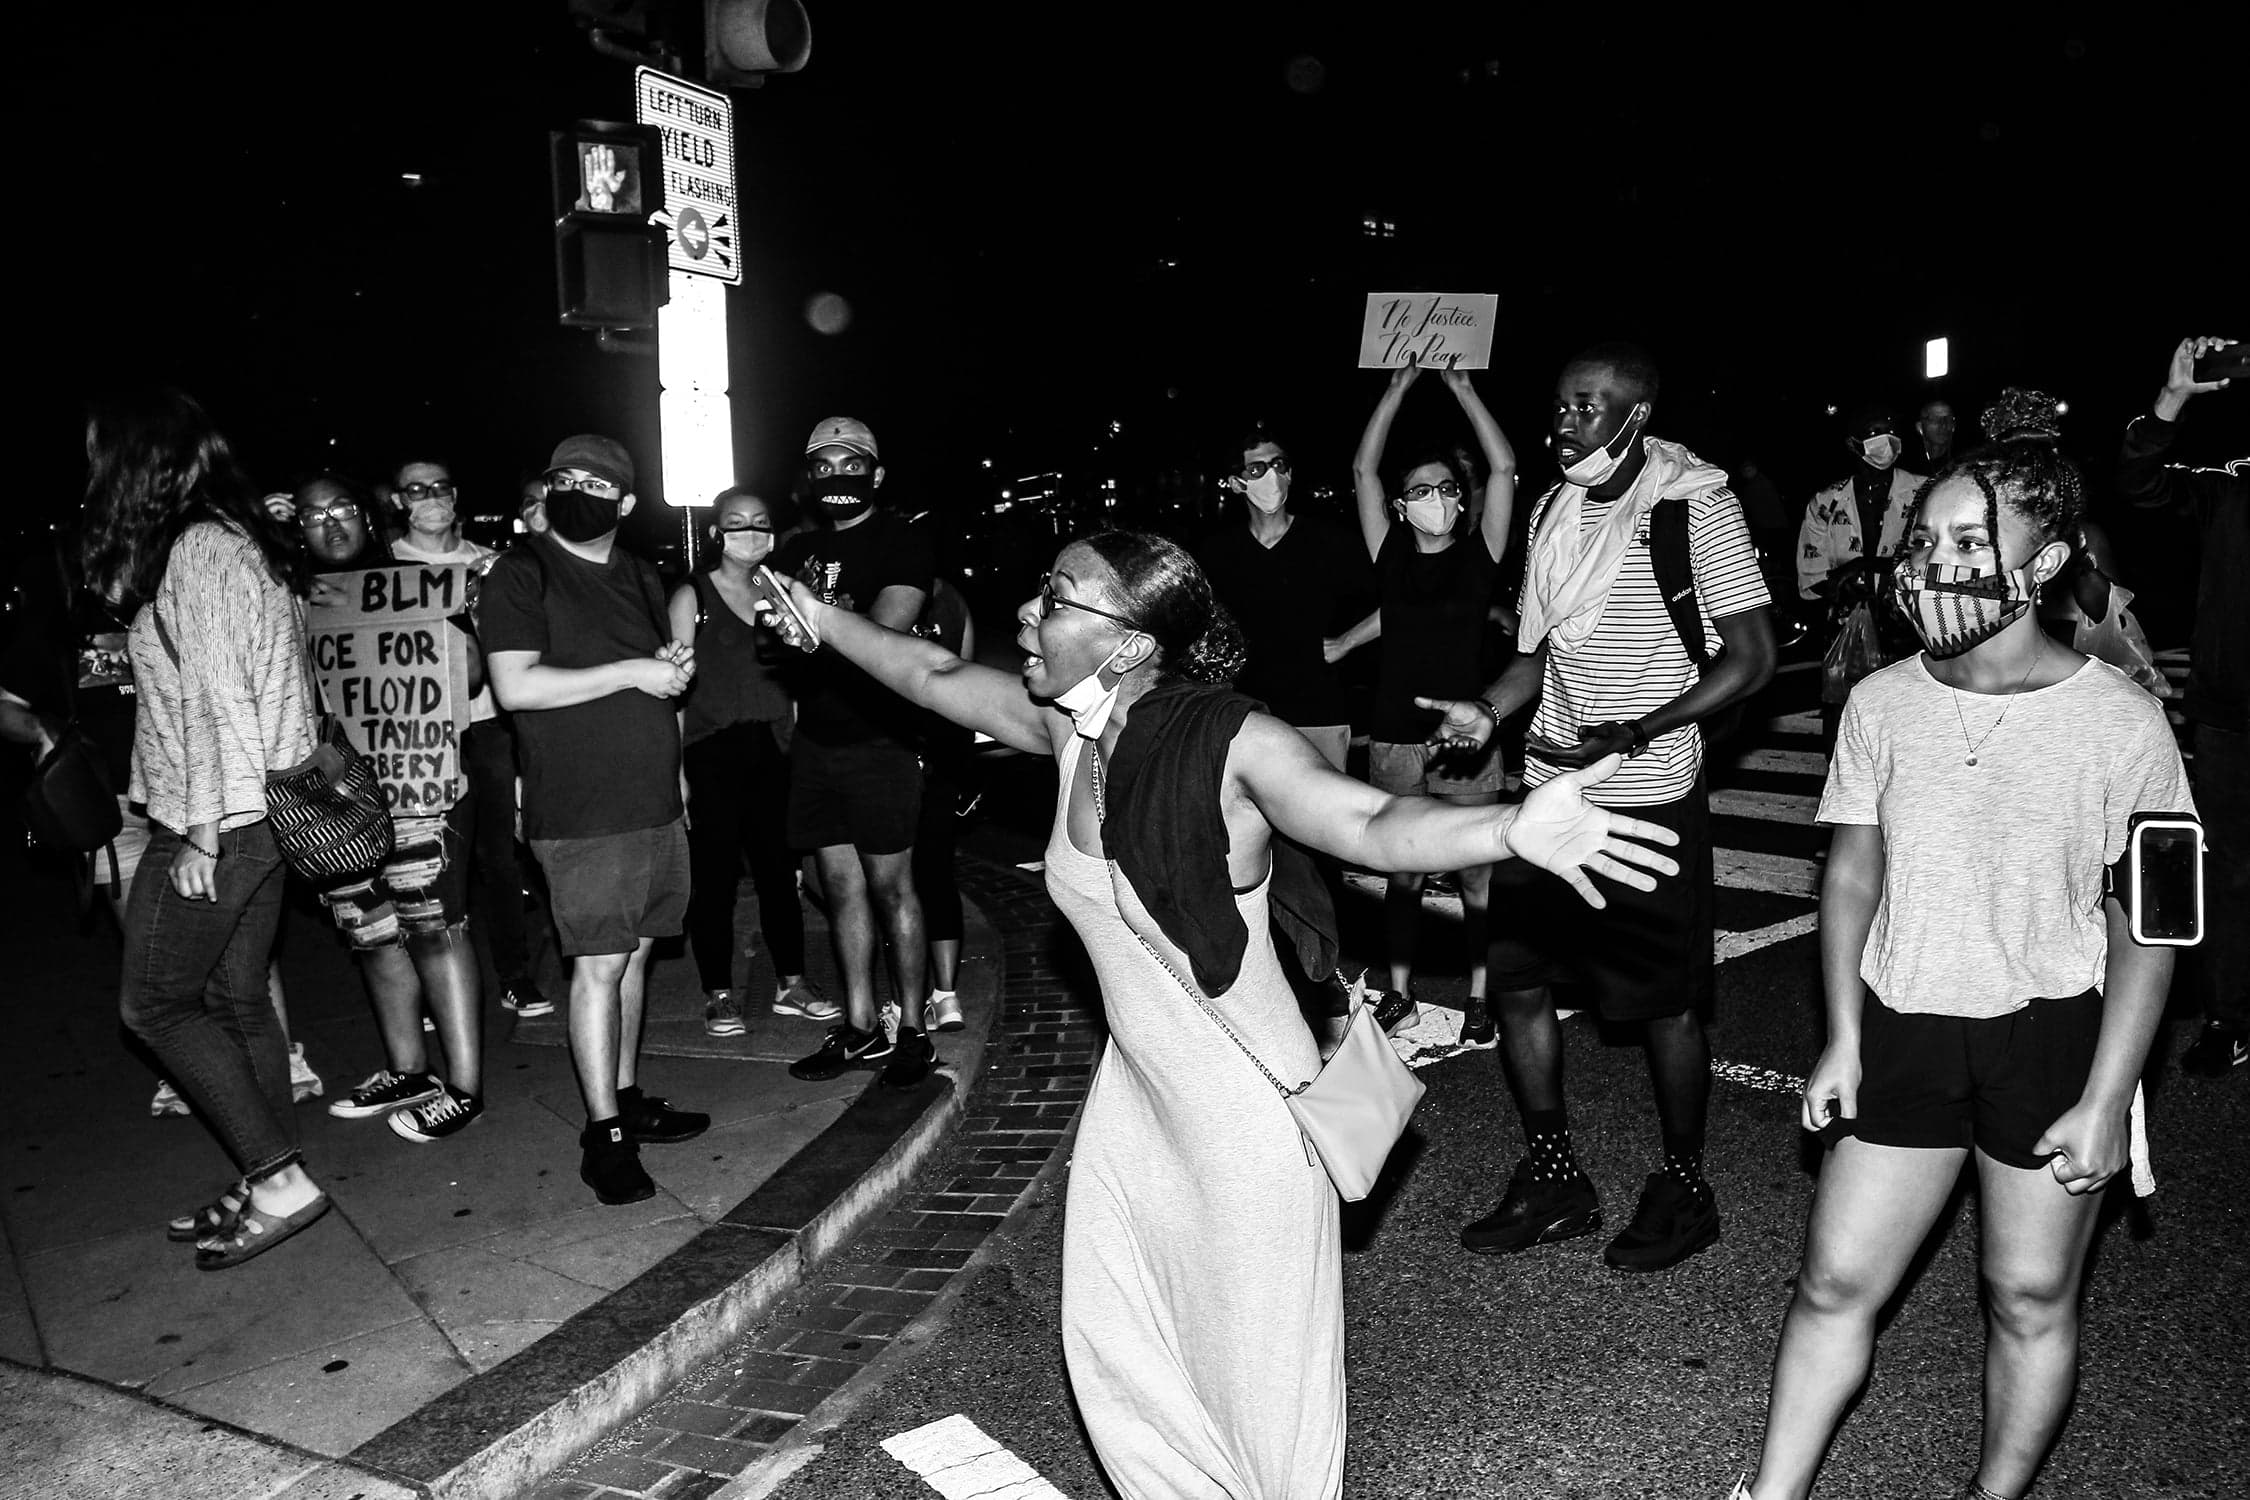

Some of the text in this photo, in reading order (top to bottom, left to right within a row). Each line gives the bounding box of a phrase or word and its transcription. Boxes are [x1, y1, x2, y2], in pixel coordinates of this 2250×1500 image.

[650, 87, 722, 131] LEFT TURN
[660, 126, 714, 168] YIELD
[672, 171, 731, 206] FLASHING
[1382, 298, 1412, 332] No
[361, 567, 454, 613] BLM
[377, 630, 440, 668] FOR
[342, 675, 442, 718] FLOYD
[361, 718, 455, 752] TAYLOR
